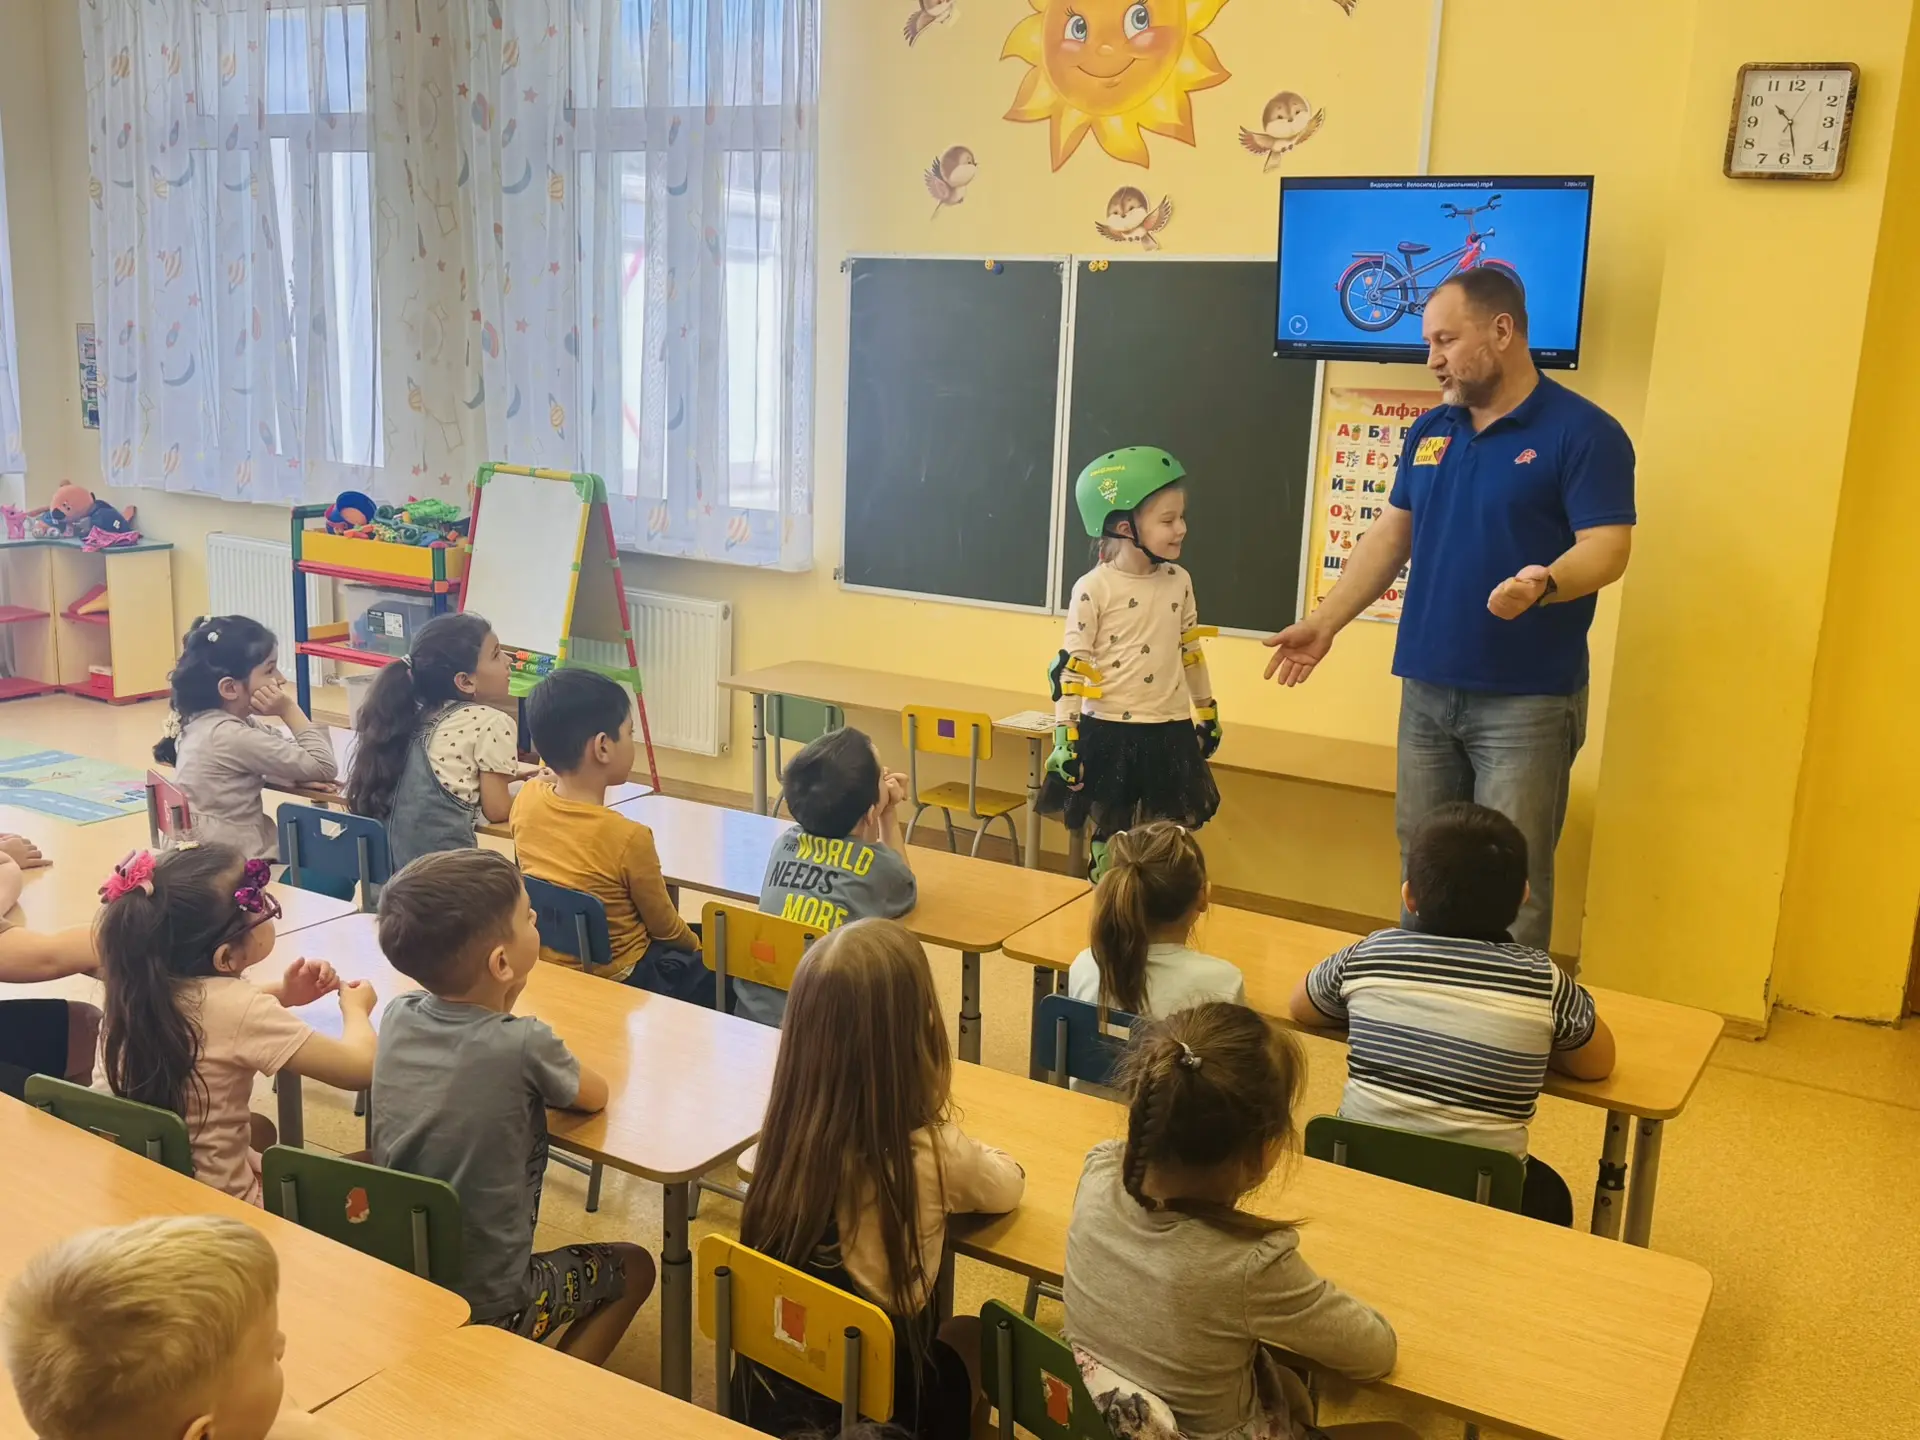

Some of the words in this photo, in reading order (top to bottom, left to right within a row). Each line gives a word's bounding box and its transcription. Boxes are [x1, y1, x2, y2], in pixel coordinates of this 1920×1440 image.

[1768, 80, 1780, 92] 11
[1788, 79, 1806, 92] 12
[1818, 80, 1824, 92] 1
[1750, 95, 1764, 107] 10
[1826, 95, 1838, 107] 2
[1747, 116, 1759, 128] 9
[1822, 116, 1835, 128] 3
[1743, 138, 1755, 150] 8
[1817, 140, 1830, 152] 4
[1757, 153, 1768, 165] 7
[1778, 152, 1790, 165] 6
[1802, 154, 1814, 166] 5
[1337, 423, 1350, 437] А
[1368, 425, 1380, 438] Б
[1335, 451, 1346, 464] Е
[1366, 449, 1377, 466] Ё
[1331, 475, 1344, 491] Й
[1362, 479, 1375, 493] К
[1330, 504, 1343, 517] О
[1360, 506, 1373, 520] П
[1329, 530, 1341, 544] У
[1323, 555, 1341, 569] Ш
[783, 842, 797, 853] THE
[795, 832, 875, 876] WORLD
[768, 860, 839, 895] NEEDS
[780, 892, 849, 934] MORE
